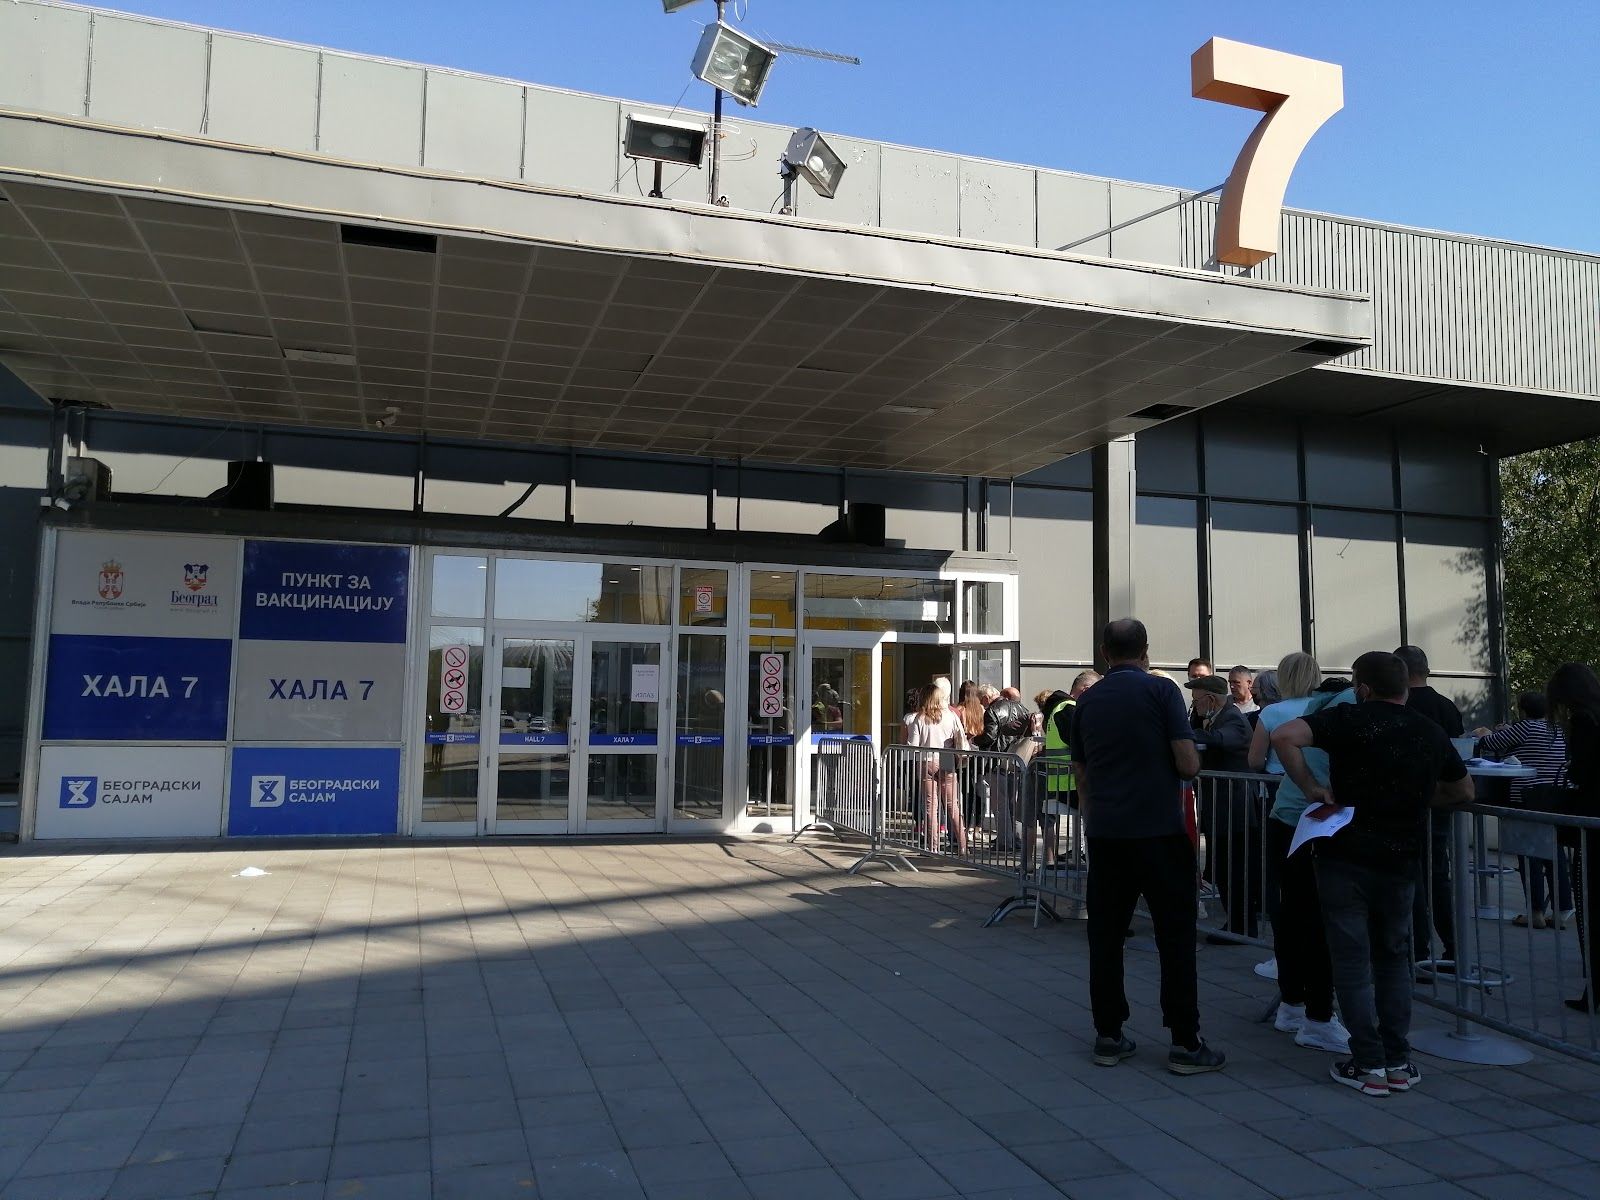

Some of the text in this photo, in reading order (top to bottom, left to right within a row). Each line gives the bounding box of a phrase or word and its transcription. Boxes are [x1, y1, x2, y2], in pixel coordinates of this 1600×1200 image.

[1191, 36, 1344, 267] 7
[281, 572, 372, 590] ПУНКТ ЗА
[170, 590, 218, 608] Београд
[255, 592, 394, 613] ВАКЦИНАЦИЈУ
[80, 674, 199, 699] ХАЛА 7
[268, 678, 375, 701] ХАЛА 7
[102, 780, 202, 792] БЕОГРАДСКИ
[289, 779, 380, 791] БЕОГРАДСКИ
[101, 794, 154, 804] САЈАМ
[288, 792, 336, 803] САЈАМ
